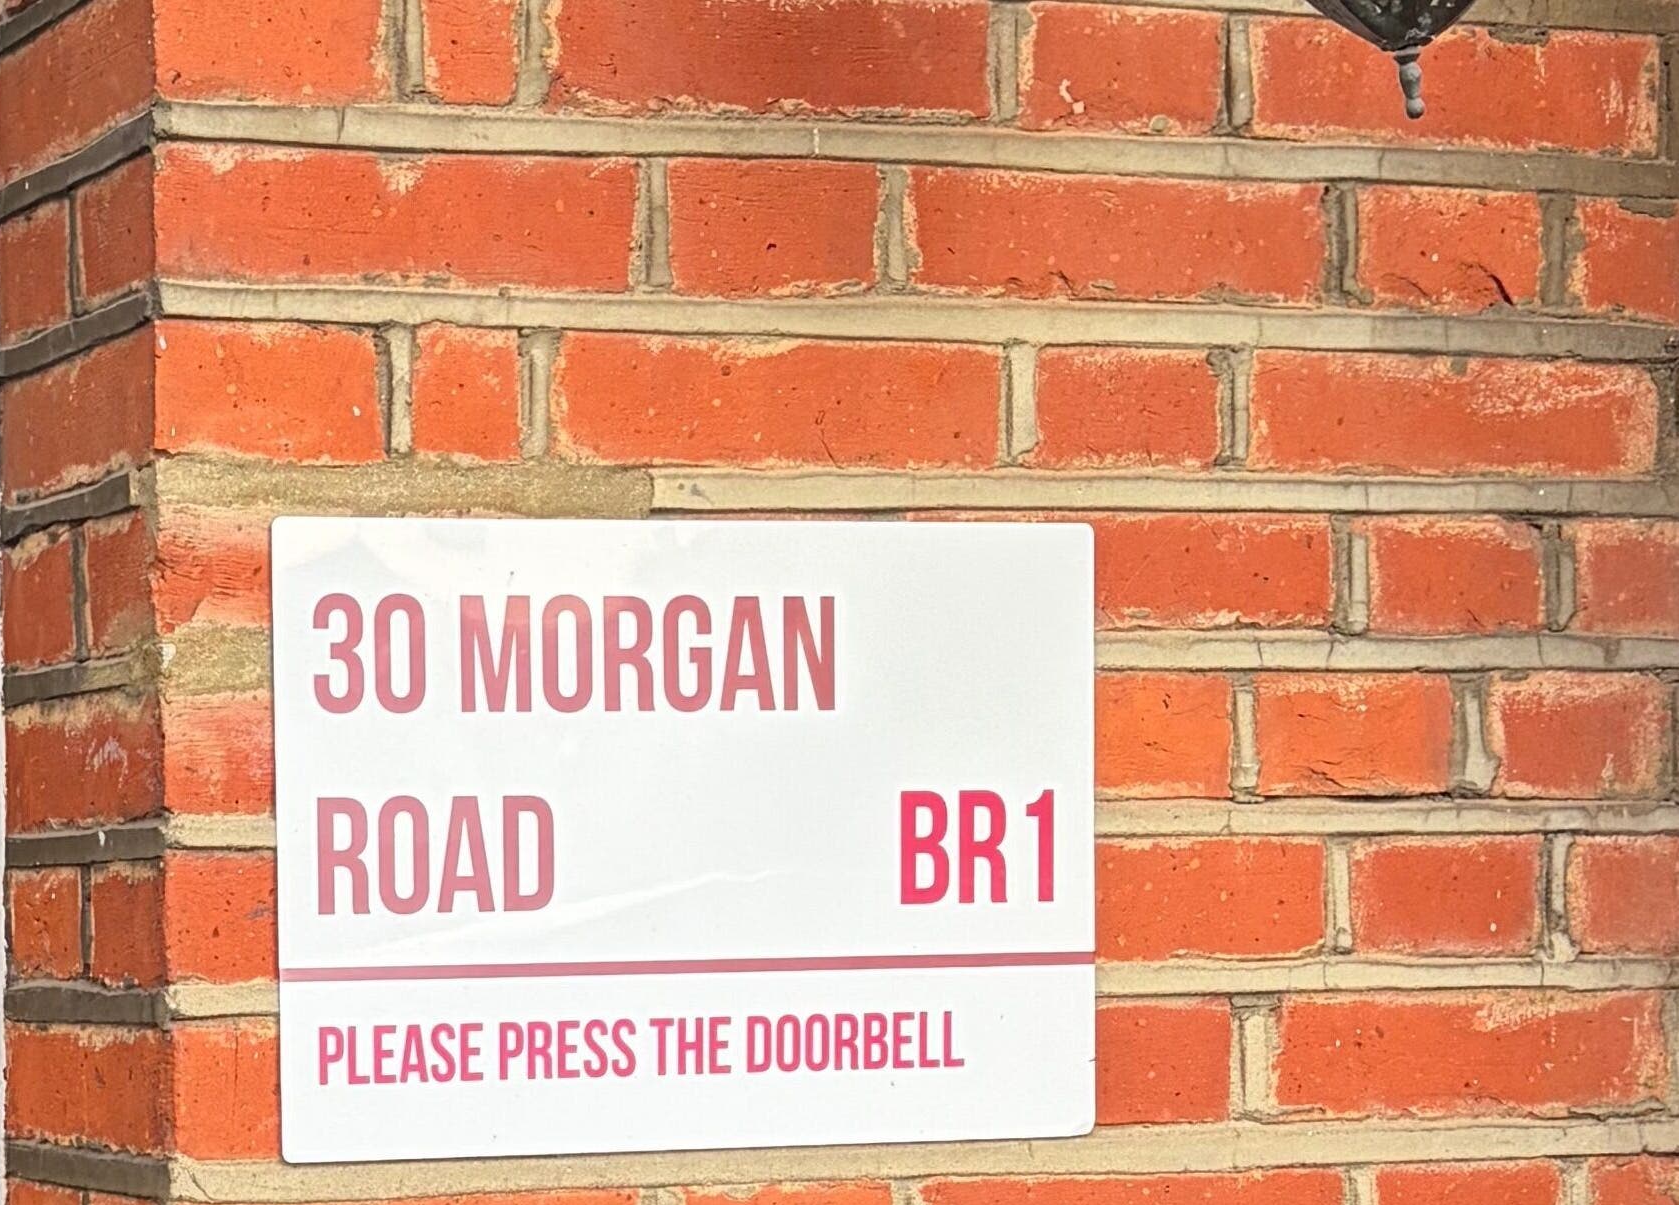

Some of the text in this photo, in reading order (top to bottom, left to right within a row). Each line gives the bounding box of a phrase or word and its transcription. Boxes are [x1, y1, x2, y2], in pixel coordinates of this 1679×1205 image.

[313, 594, 836, 713] 30 MORGAN
[317, 796, 555, 915] ROAD
[899, 789, 1056, 906] BR1
[318, 1011, 965, 1086] PLEASE PRESS THE DOORBELL
